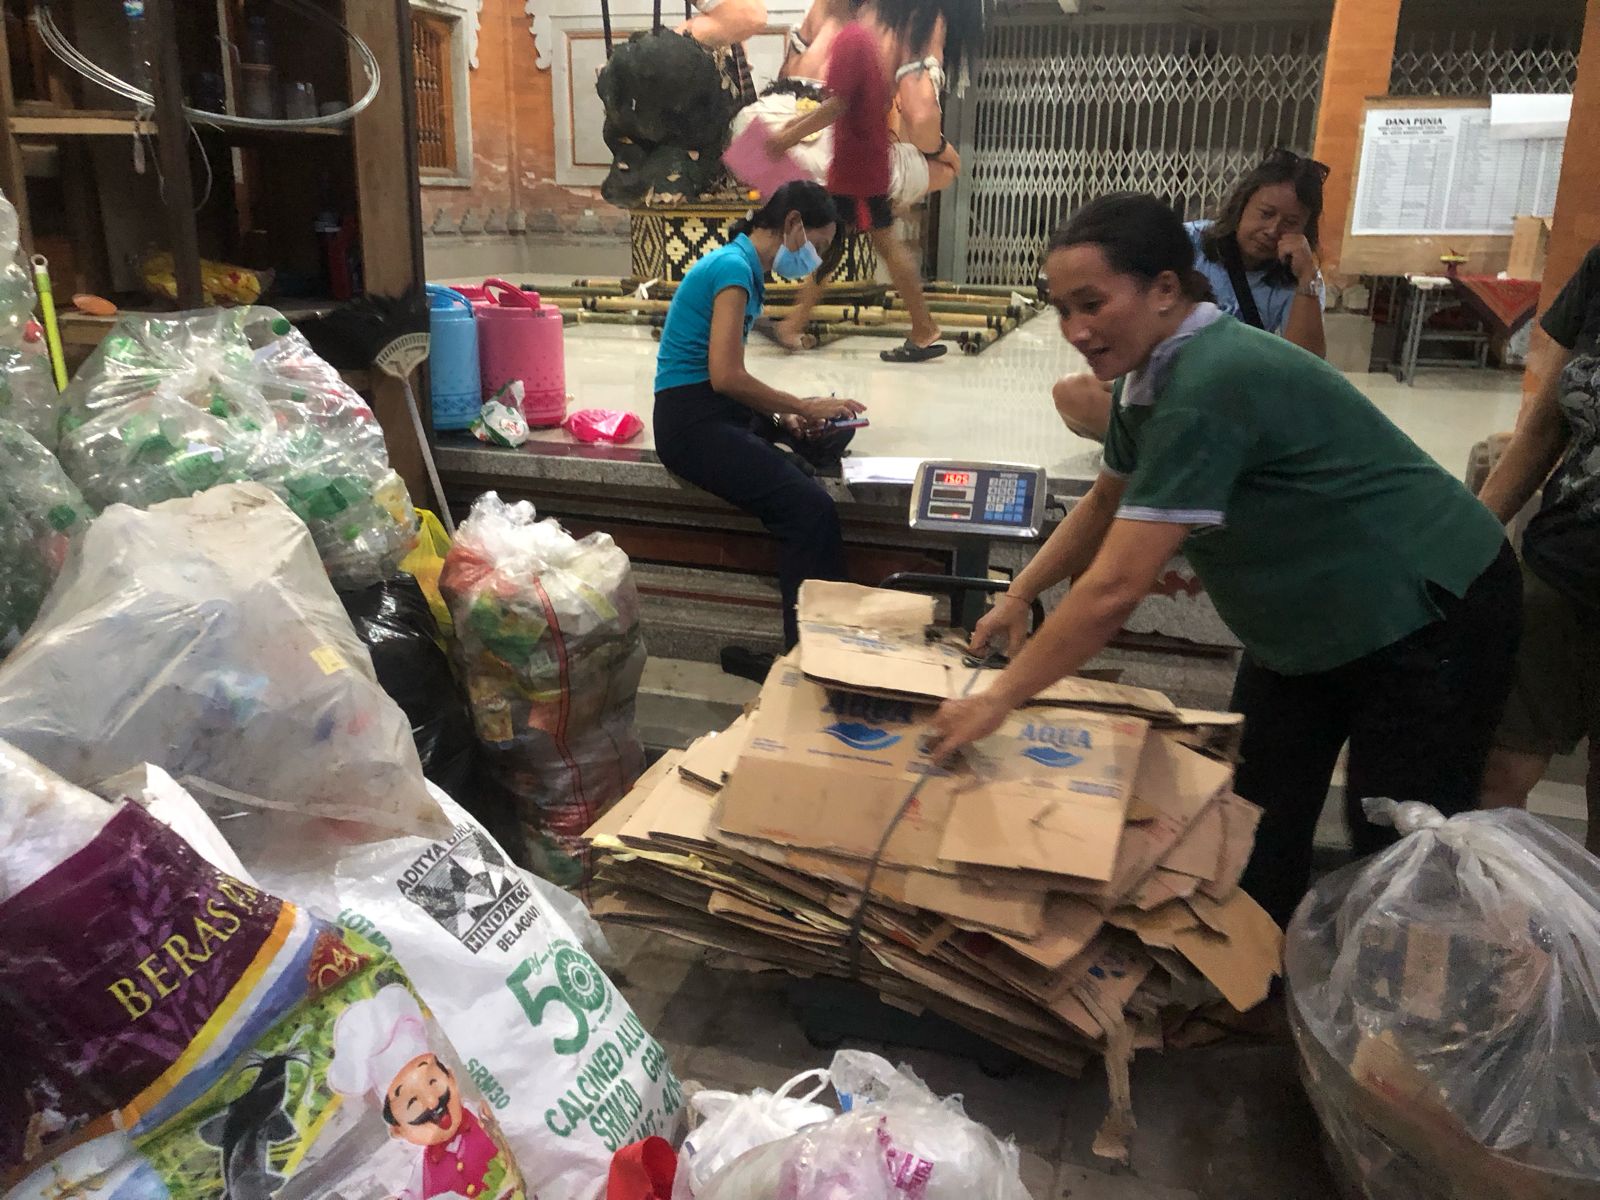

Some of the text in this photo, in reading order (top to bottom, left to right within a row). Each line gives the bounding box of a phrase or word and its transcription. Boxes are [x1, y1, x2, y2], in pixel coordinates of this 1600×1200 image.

[1385, 116, 1443, 126] DANA PUNIA
[1016, 723, 1093, 750] AQUA
[396, 842, 448, 898] ADITYA
[496, 905, 541, 952] BELAGAVI
[106, 898, 241, 1021] BERAS
[543, 1010, 646, 1138] CALCINED ALU
[589, 1078, 643, 1153] SRM30
